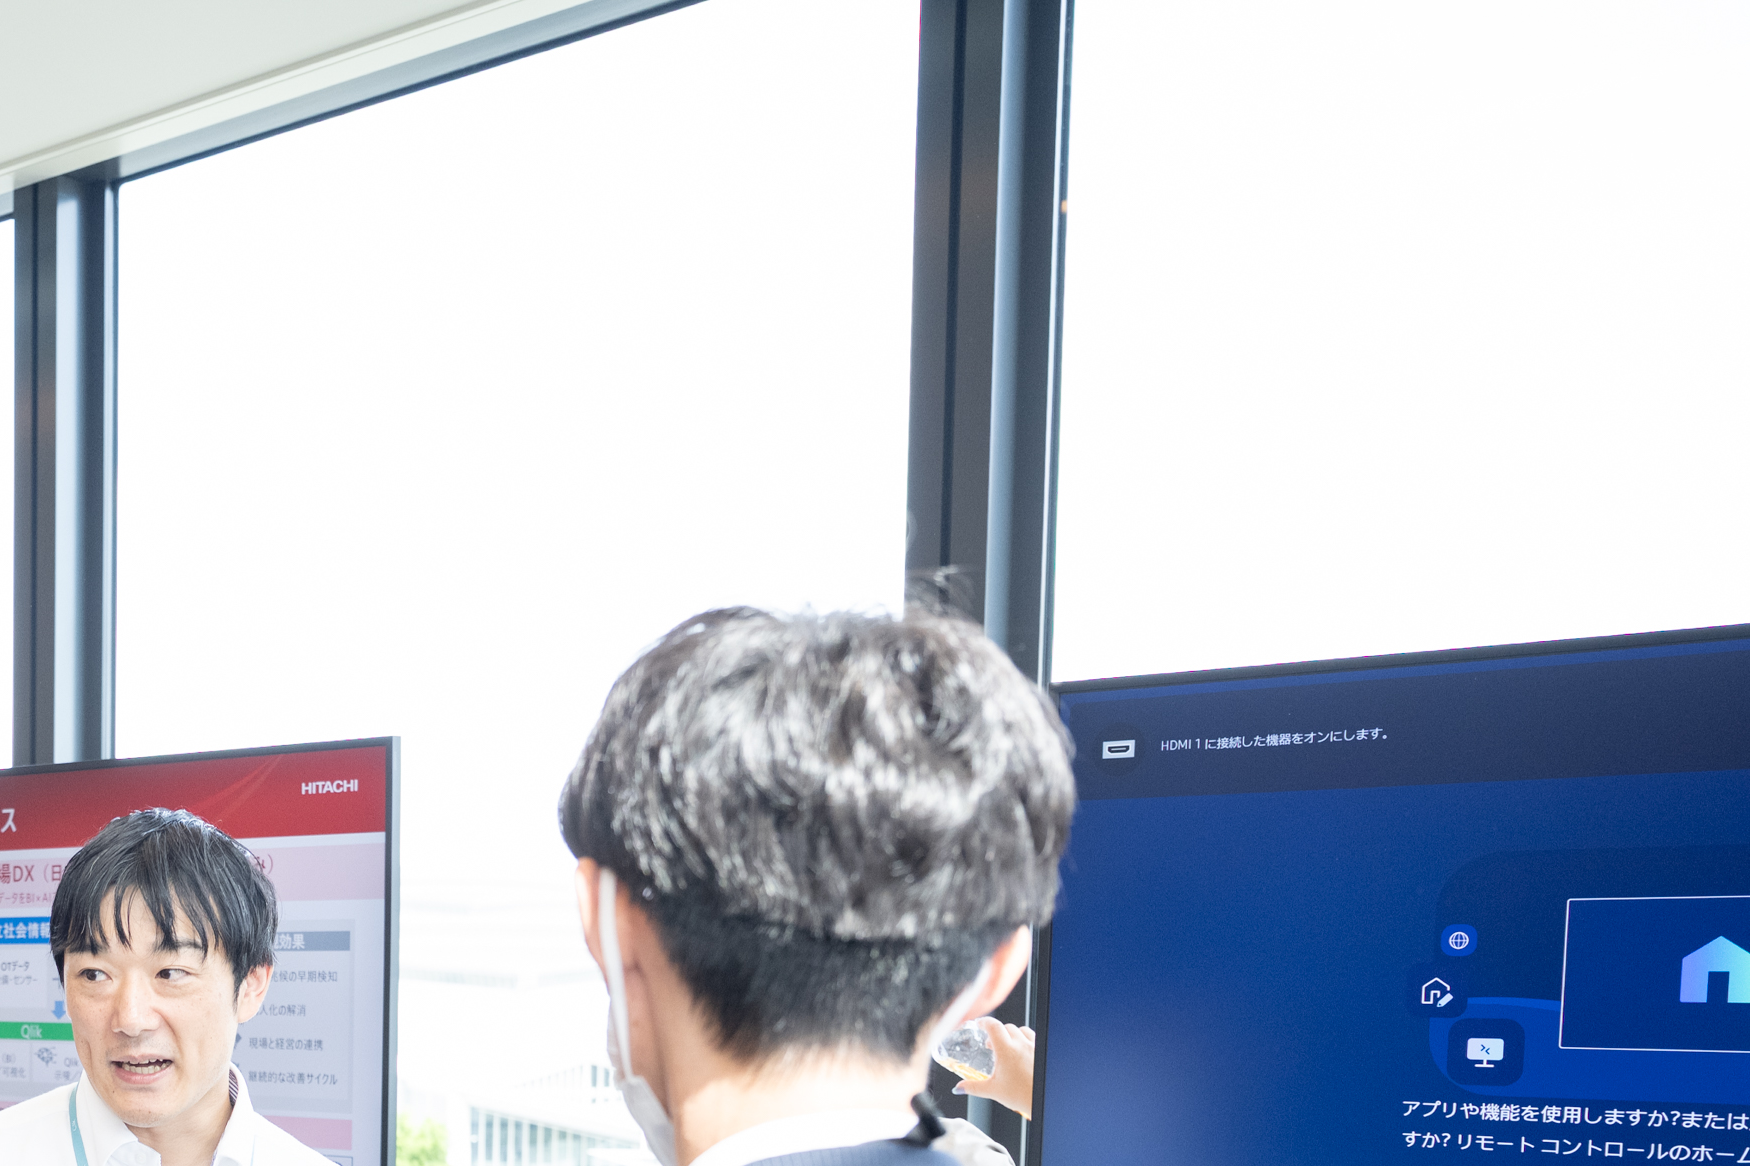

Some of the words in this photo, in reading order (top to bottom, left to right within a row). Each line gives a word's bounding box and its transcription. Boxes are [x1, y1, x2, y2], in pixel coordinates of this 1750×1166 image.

[1161, 738, 1192, 752] HDMI
[1195, 738, 1201, 749] 1
[1205, 727, 1388, 750] に接続した機器をオンにします。
[301, 779, 359, 795] HITACHI
[255, 1004, 306, 1017] 人化の解消
[20, 1023, 43, 1039] Qlik
[249, 1037, 324, 1051] 現場と経営の連携
[249, 1070, 338, 1086] 継続的な改善サイクル
[1457, 1133, 1535, 1154] リモート
[1541, 1138, 1750, 1164] コントロールのホーム
